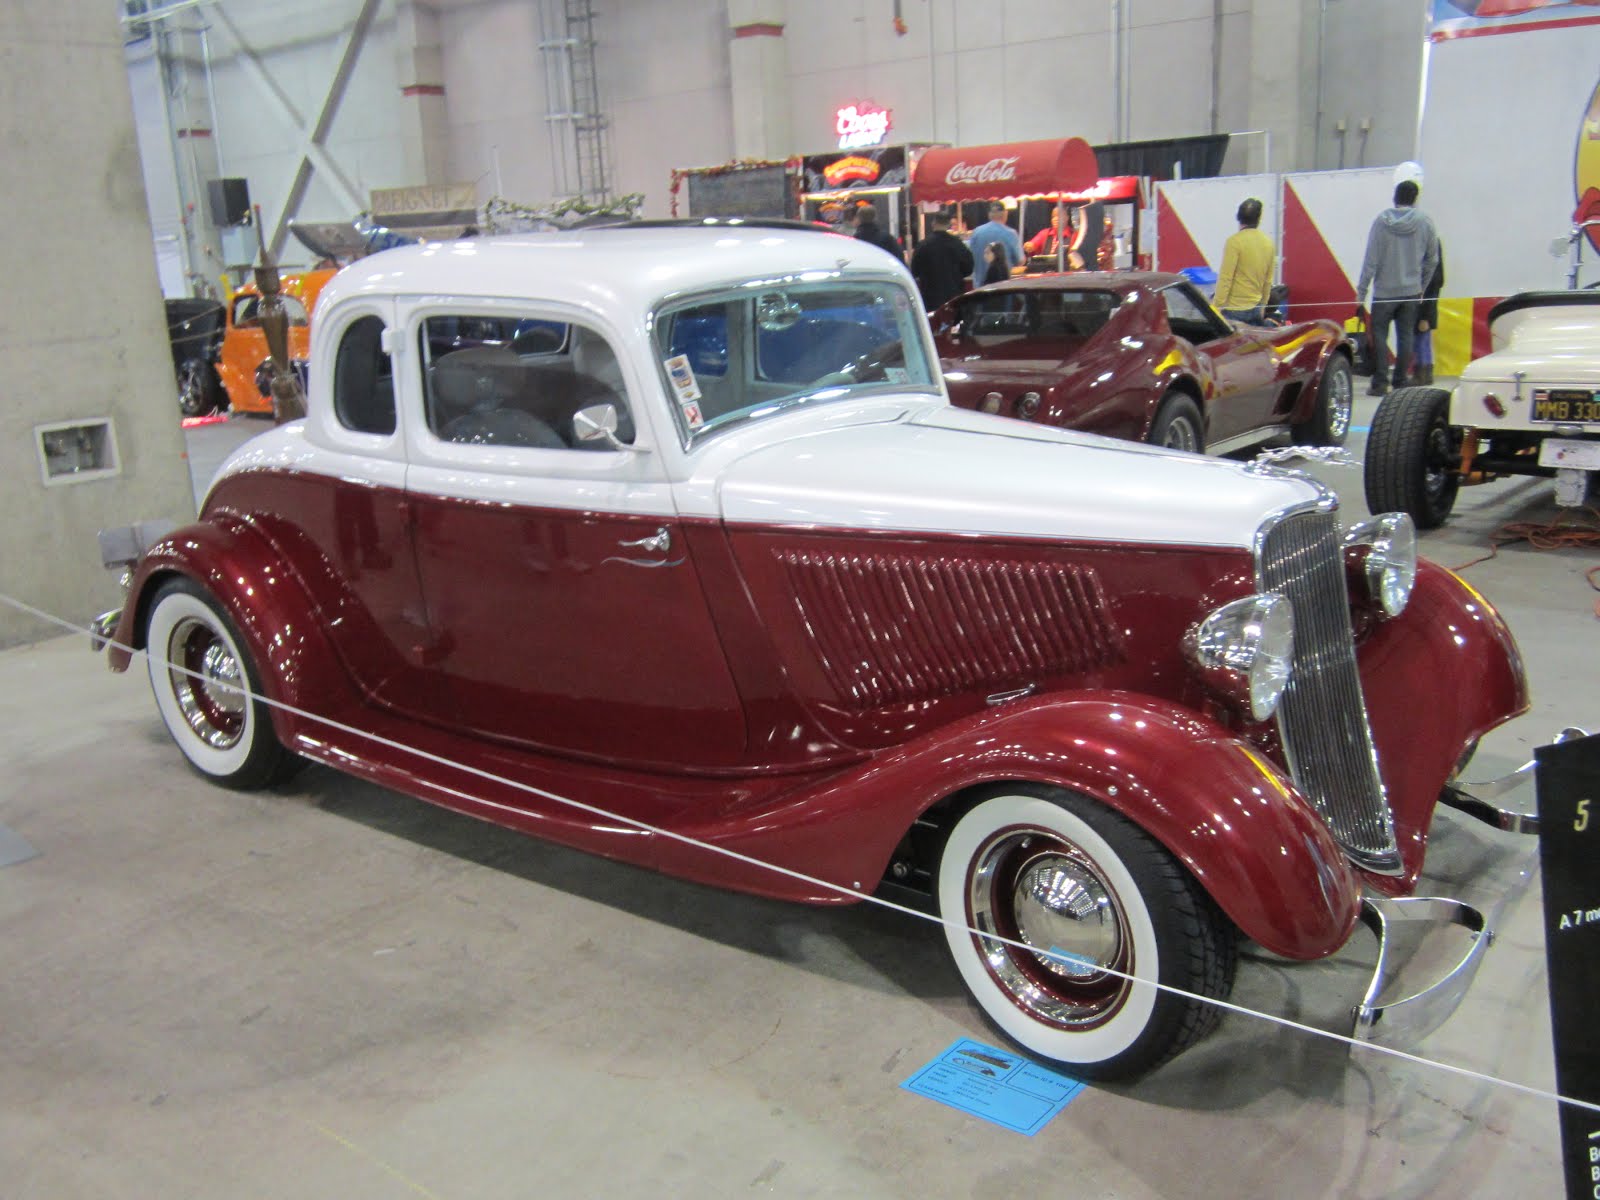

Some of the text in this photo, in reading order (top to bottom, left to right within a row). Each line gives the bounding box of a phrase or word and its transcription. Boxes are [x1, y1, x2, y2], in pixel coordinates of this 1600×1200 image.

[945, 156, 1020, 185] Coca-Cola
[1536, 401, 1570, 420] MMB
[1559, 914, 1571, 929] A
[1573, 910, 1582, 925] 7
